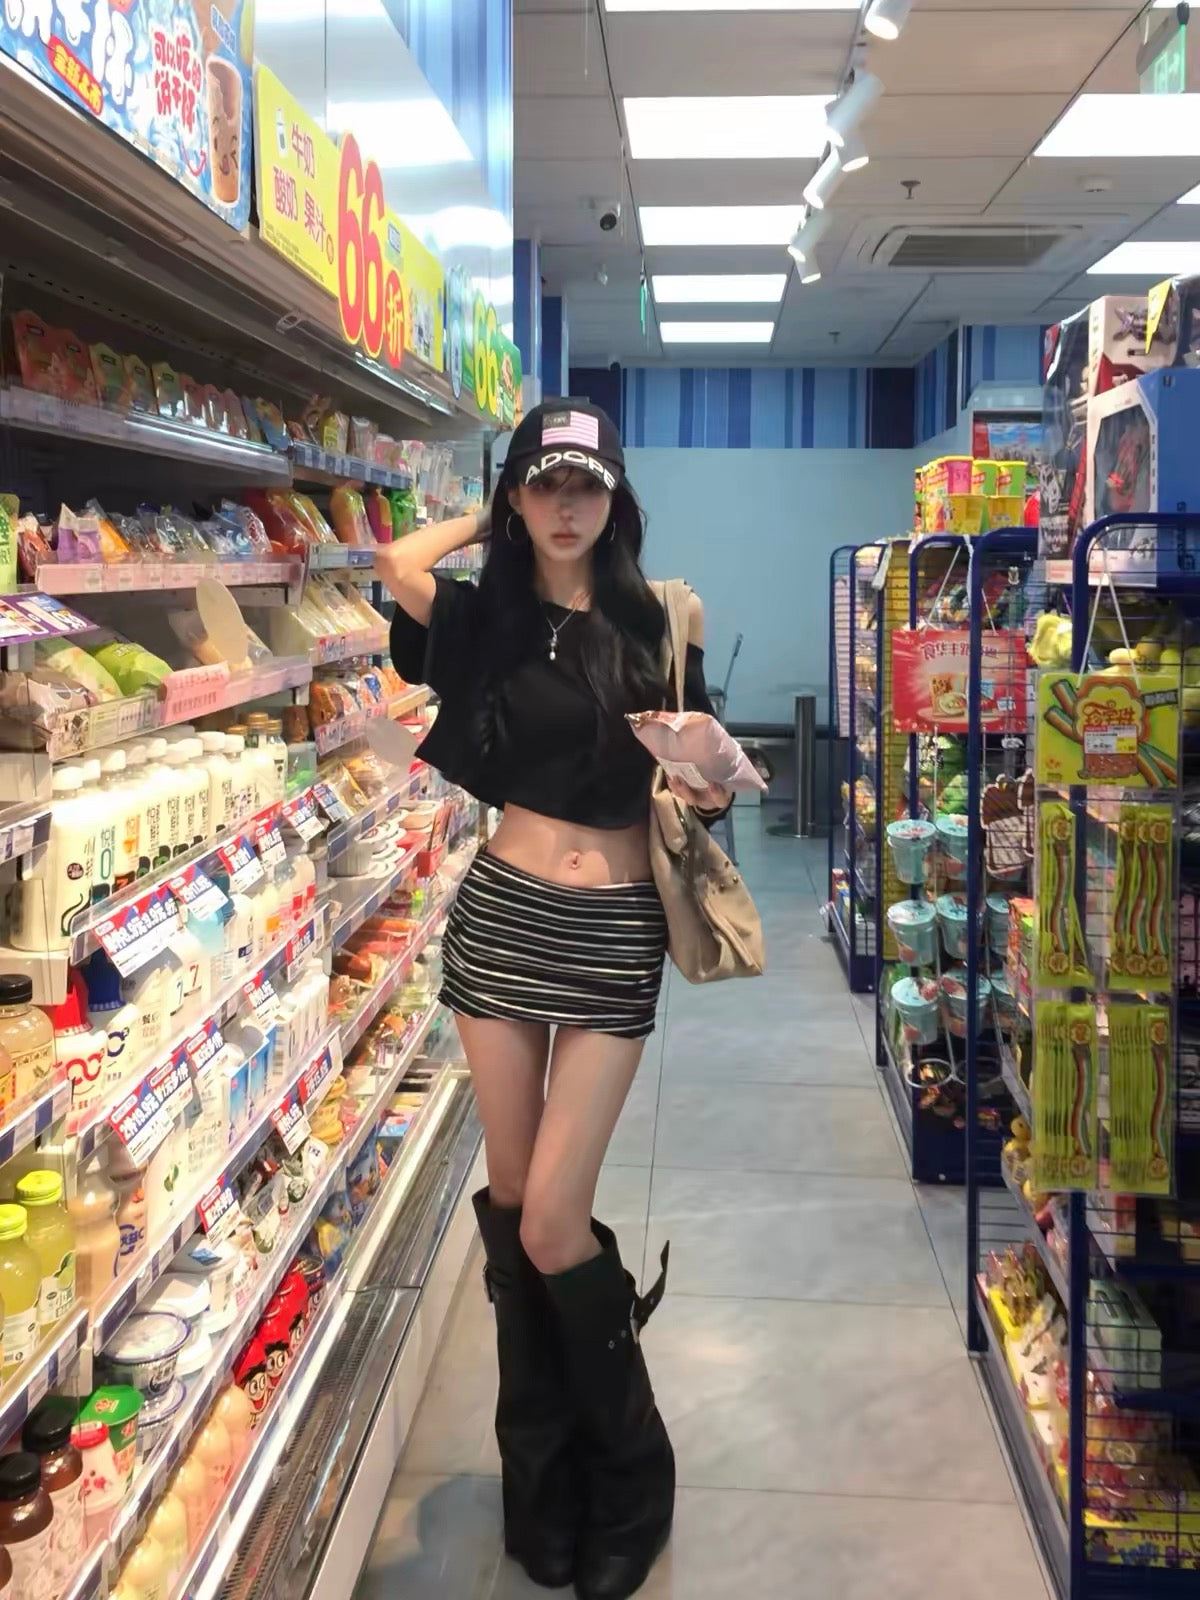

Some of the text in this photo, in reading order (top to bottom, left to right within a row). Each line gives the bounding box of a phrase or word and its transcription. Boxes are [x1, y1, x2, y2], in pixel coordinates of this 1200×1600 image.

[154, 31, 202, 94] 可以吃的
[291, 123, 315, 179] 牛奶
[272, 165, 299, 222] 酸奶
[303, 189, 327, 252] 果汁
[338, 132, 405, 366] 66折
[473, 290, 500, 418] 66
[119, 1091, 160, 1140] 2件19.9元
